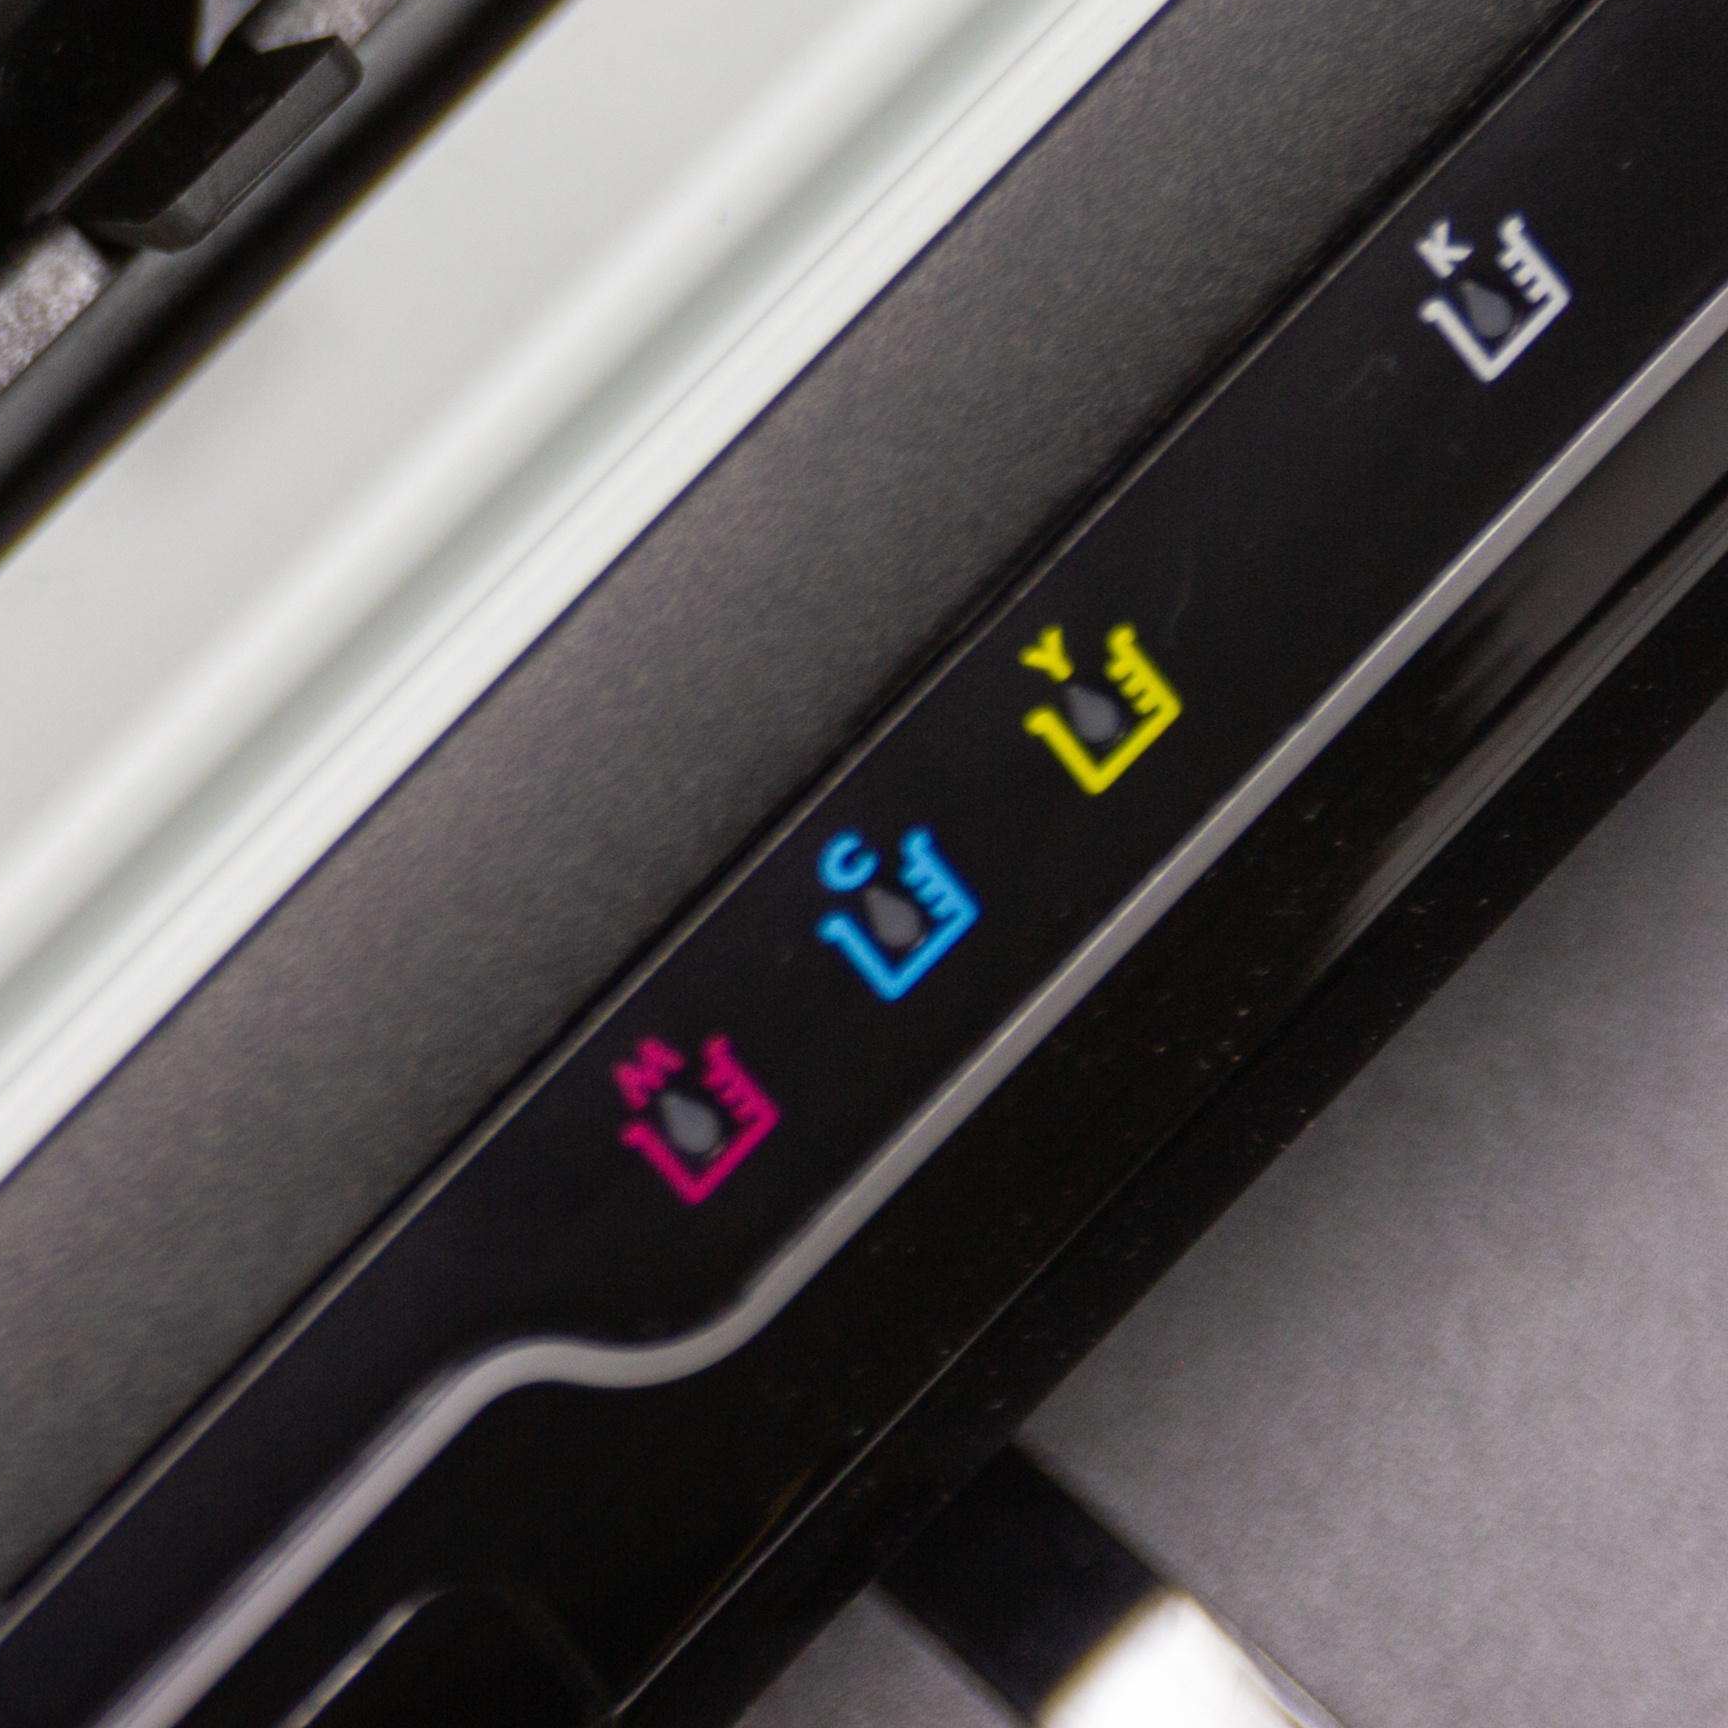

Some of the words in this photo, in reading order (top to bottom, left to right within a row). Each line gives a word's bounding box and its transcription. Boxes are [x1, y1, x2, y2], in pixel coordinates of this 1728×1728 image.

[1417, 219, 1472, 277] K
[1021, 626, 1074, 682] Y
[817, 831, 879, 892] C
[615, 1038, 684, 1107] M
